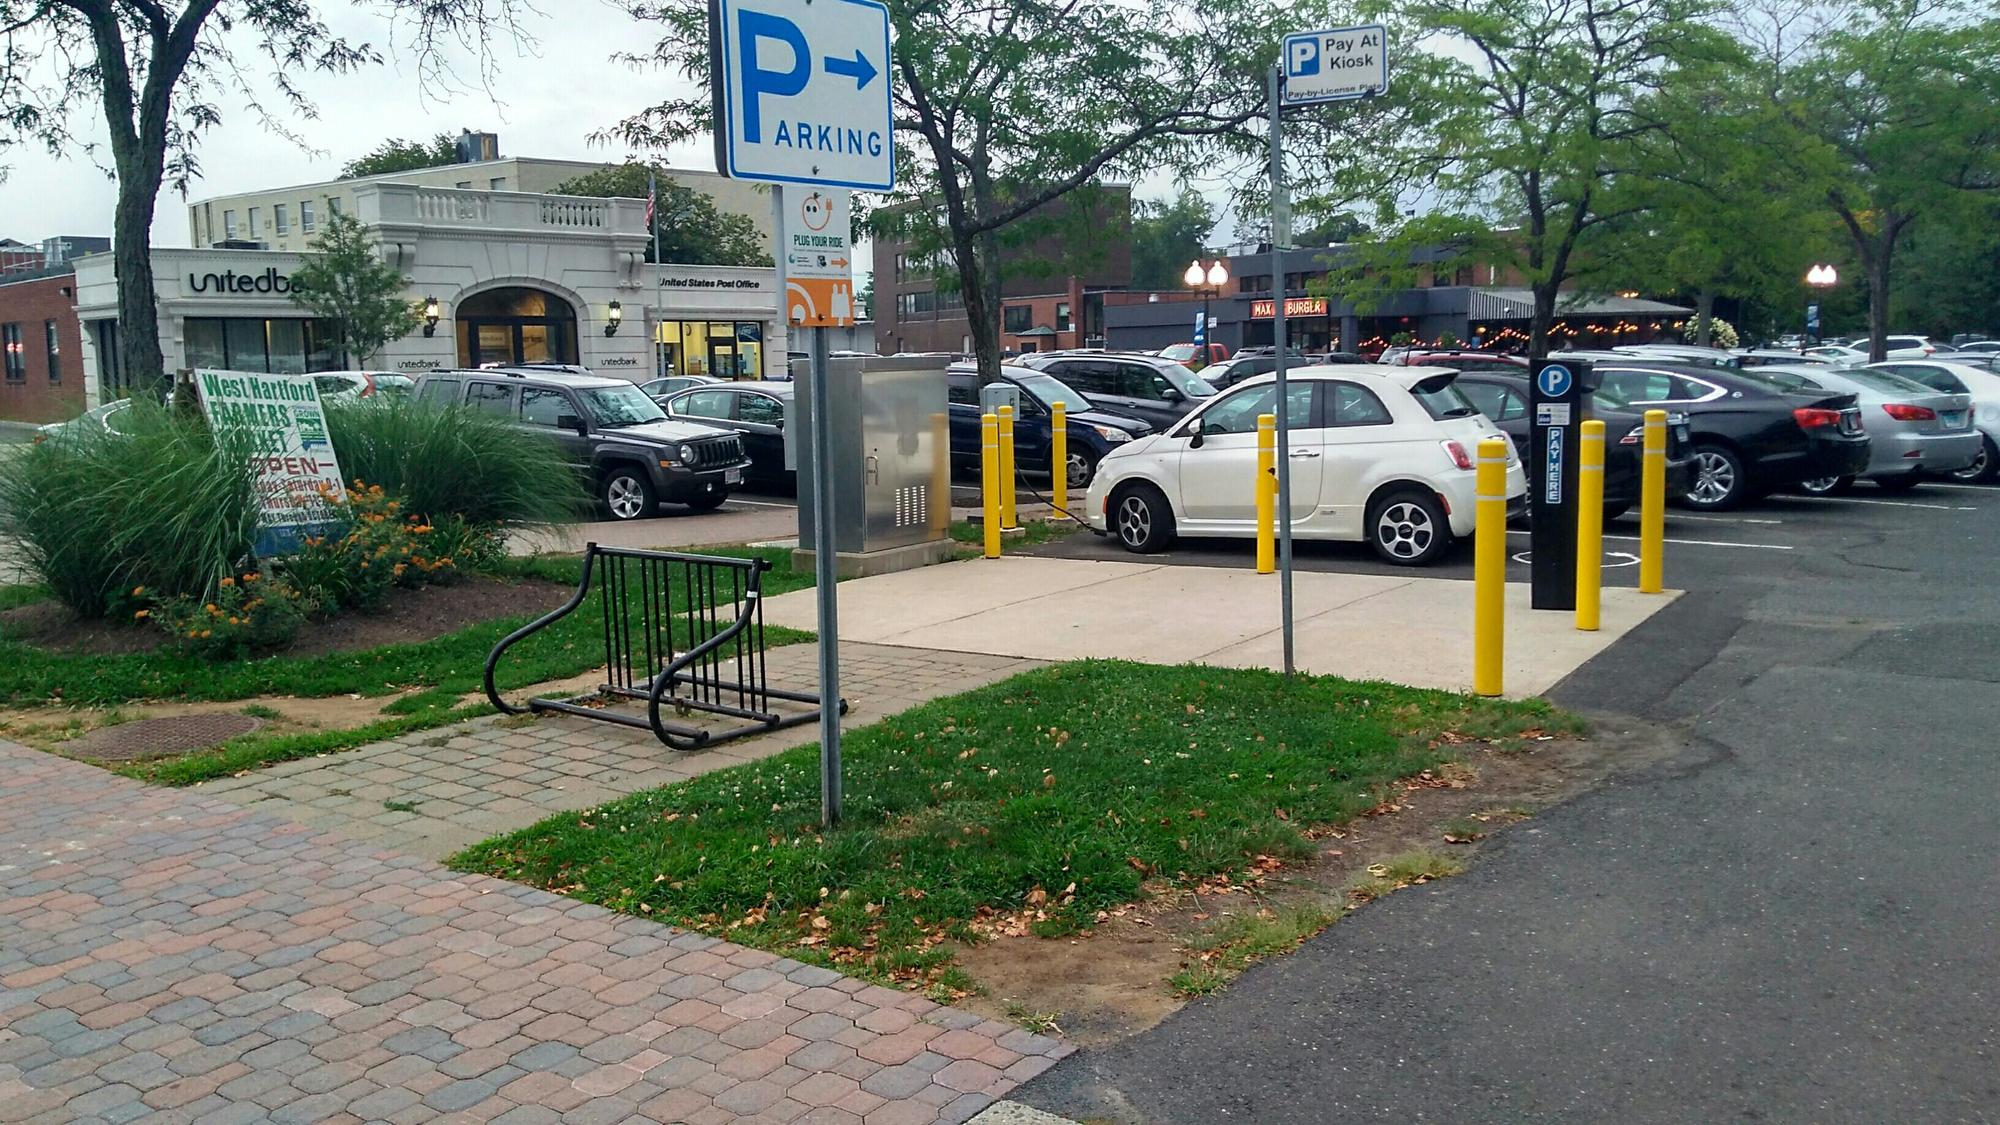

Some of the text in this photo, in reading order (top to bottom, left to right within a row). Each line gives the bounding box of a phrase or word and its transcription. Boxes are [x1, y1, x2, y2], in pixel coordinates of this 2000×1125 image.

[1326, 34, 1379, 52] Pay At
[1291, 42, 1316, 73] P
[1330, 53, 1374, 70] Kiosk
[1288, 86, 1356, 98] Pay-by-License
[793, 234, 843, 248] PLUG YOUR RIDE
[688, 279, 715, 288] States
[716, 280, 735, 288] Post
[735, 280, 760, 289] Office
[1255, 303, 1271, 315] MAX
[397, 359, 440, 368] unitedbank
[600, 357, 638, 366] unitedbank
[202, 373, 316, 402] West Hartford
[1548, 370, 1563, 391] P
[1549, 430, 1560, 501] PAY HERE
